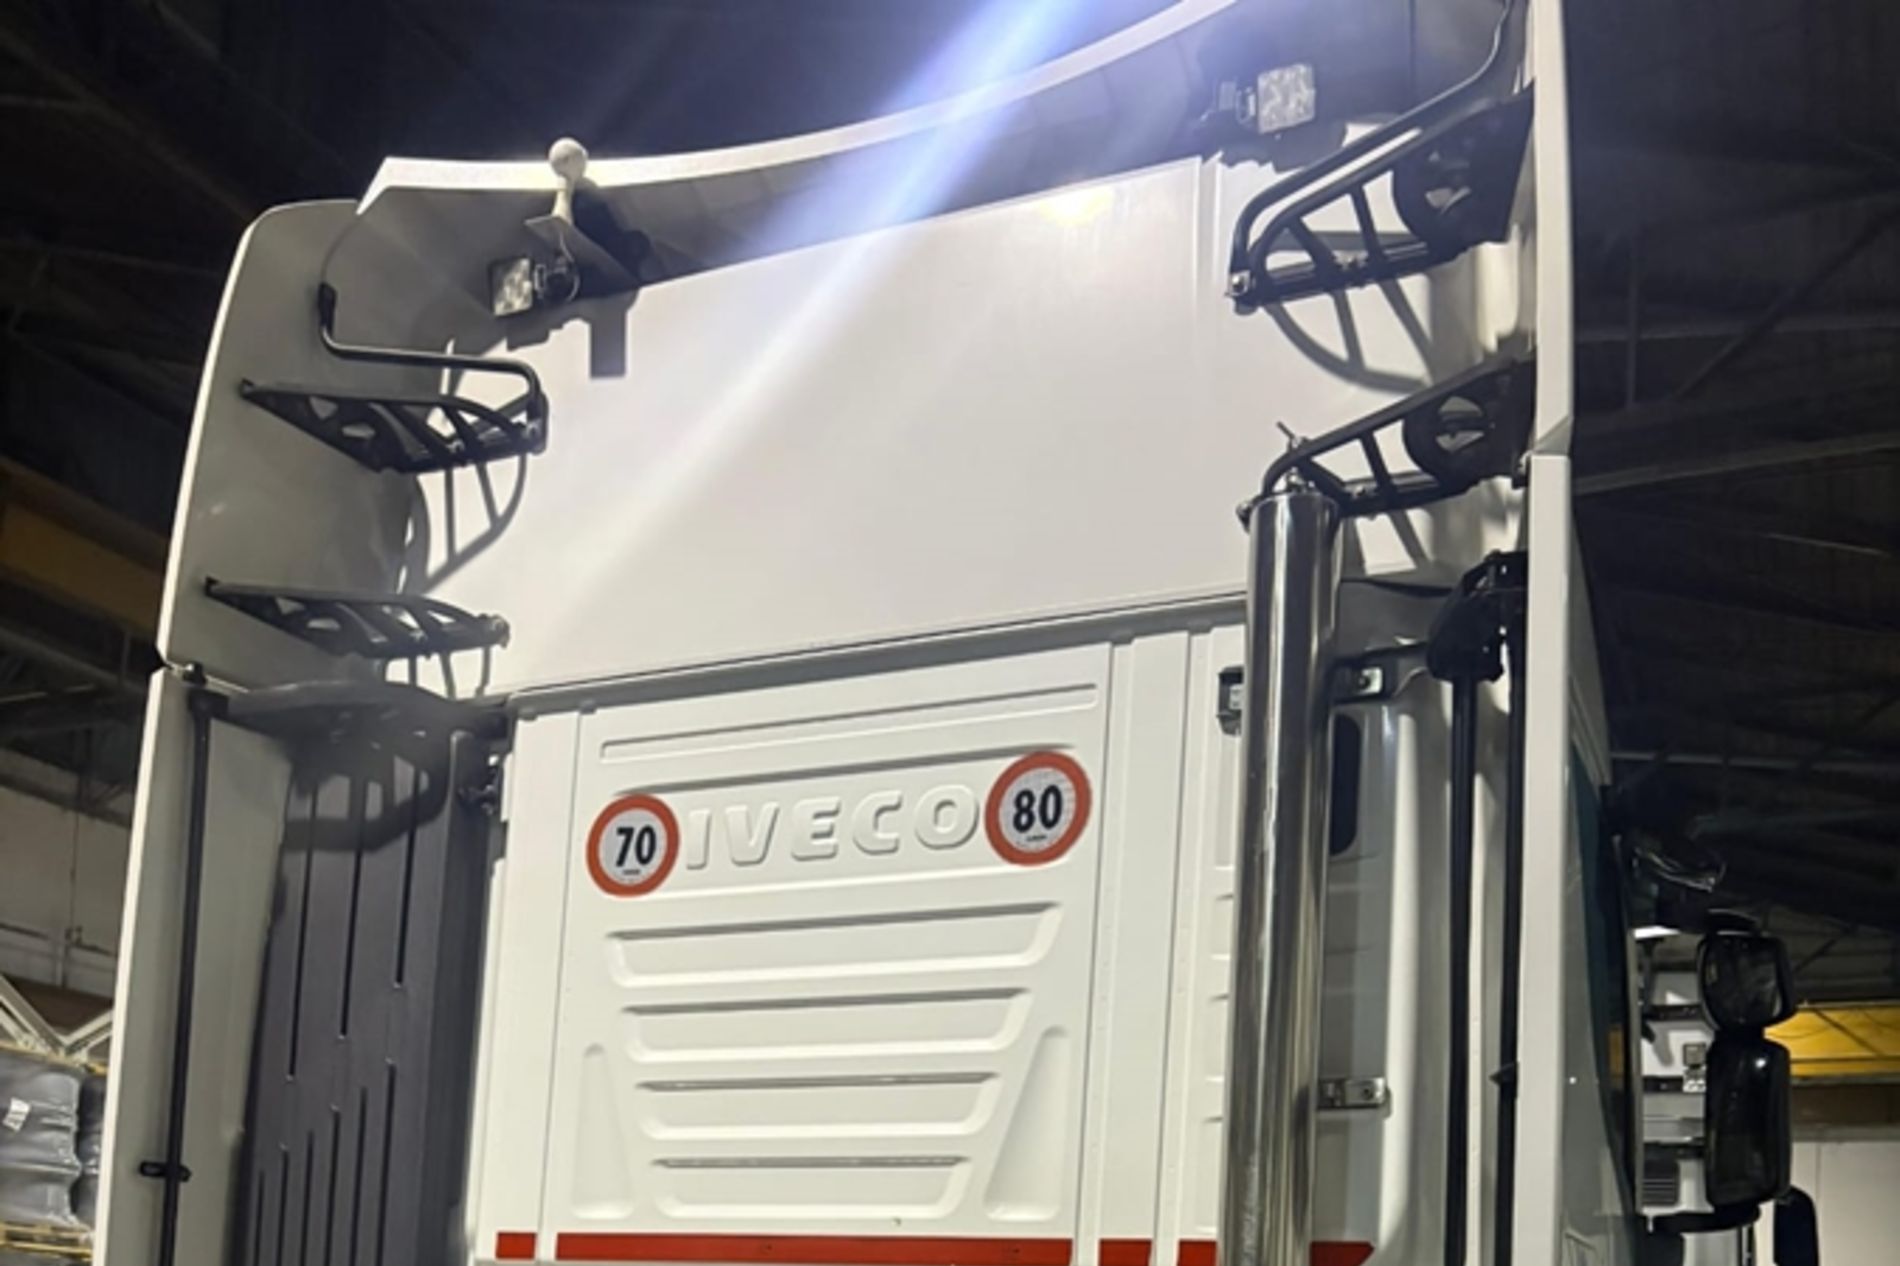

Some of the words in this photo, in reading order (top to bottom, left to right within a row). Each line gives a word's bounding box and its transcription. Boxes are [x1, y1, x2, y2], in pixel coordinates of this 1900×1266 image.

[686, 784, 980, 871] IVECO
[1013, 784, 1063, 834] 80
[616, 824, 657, 868] 70
